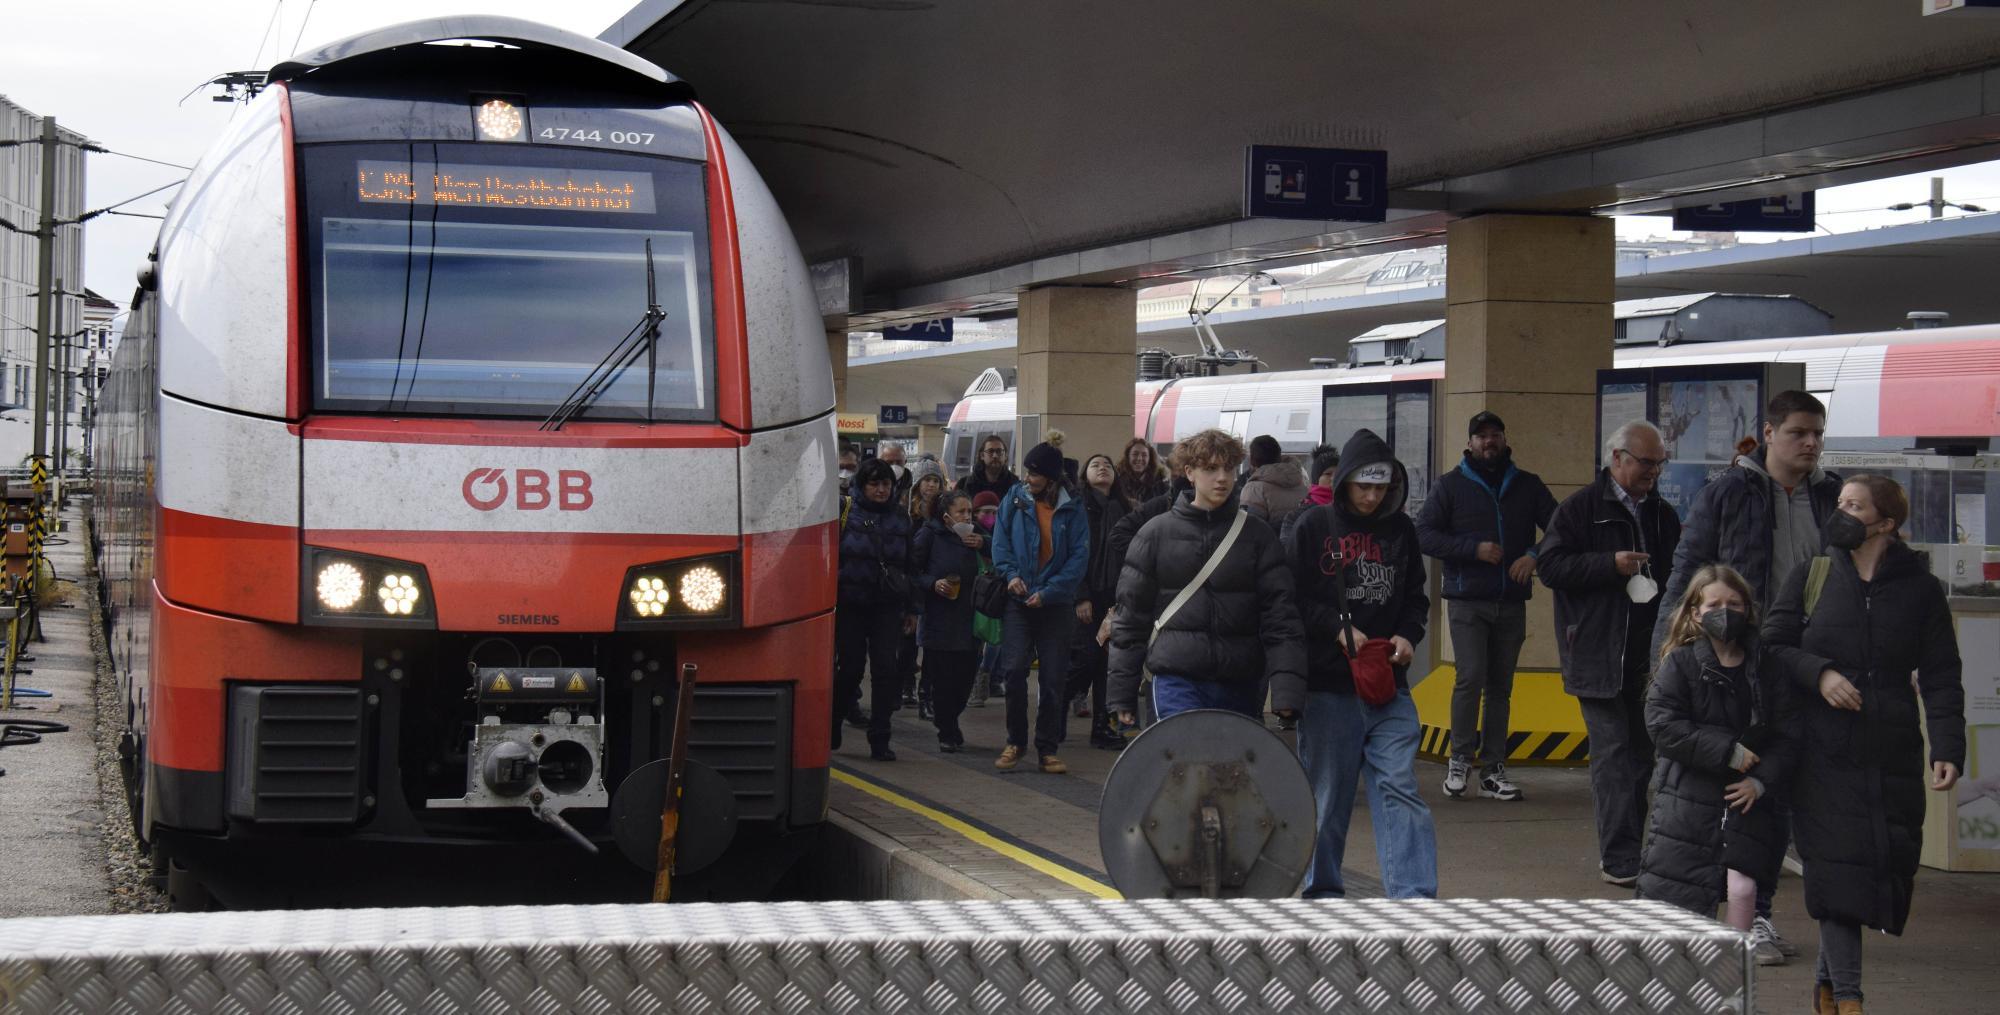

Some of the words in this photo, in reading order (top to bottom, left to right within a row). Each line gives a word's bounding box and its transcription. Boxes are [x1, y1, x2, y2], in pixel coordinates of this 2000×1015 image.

[540, 127, 603, 142] 4744
[610, 131, 655, 145] 007
[884, 408, 894, 420] 4
[897, 411, 905, 421] B
[462, 467, 594, 512] ÖBB
[498, 614, 560, 626] SIEMENS
